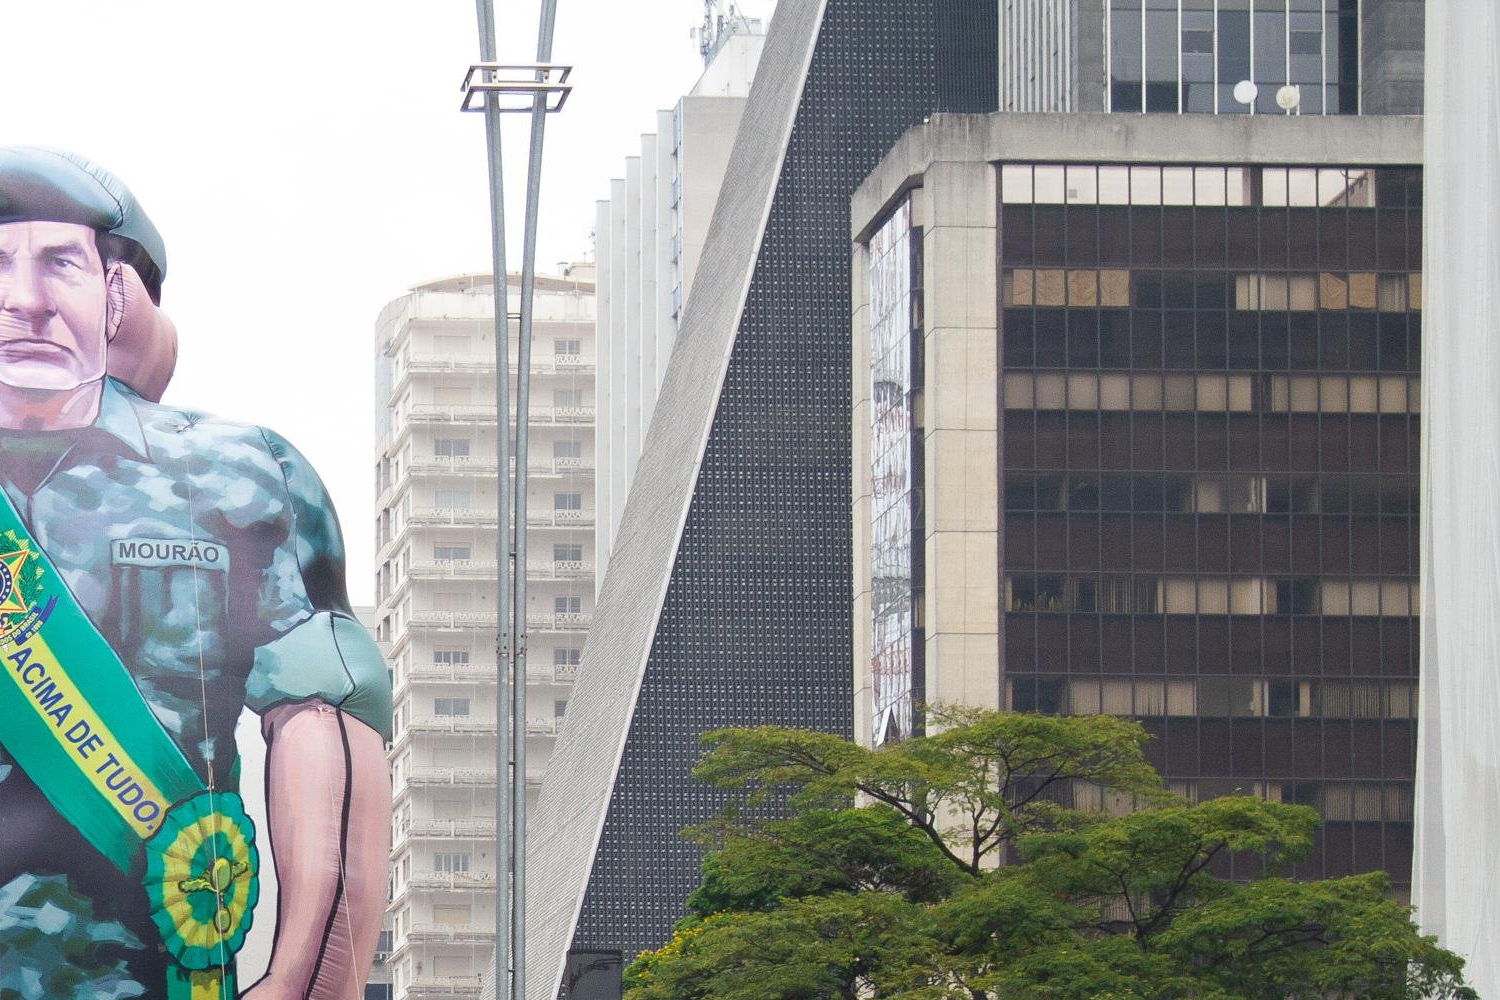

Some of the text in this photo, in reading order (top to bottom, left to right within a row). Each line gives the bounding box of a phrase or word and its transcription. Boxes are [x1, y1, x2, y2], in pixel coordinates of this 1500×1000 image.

[119, 541, 220, 563] MOURÃO
[7, 647, 160, 831] ACIMA DE TUDO.
